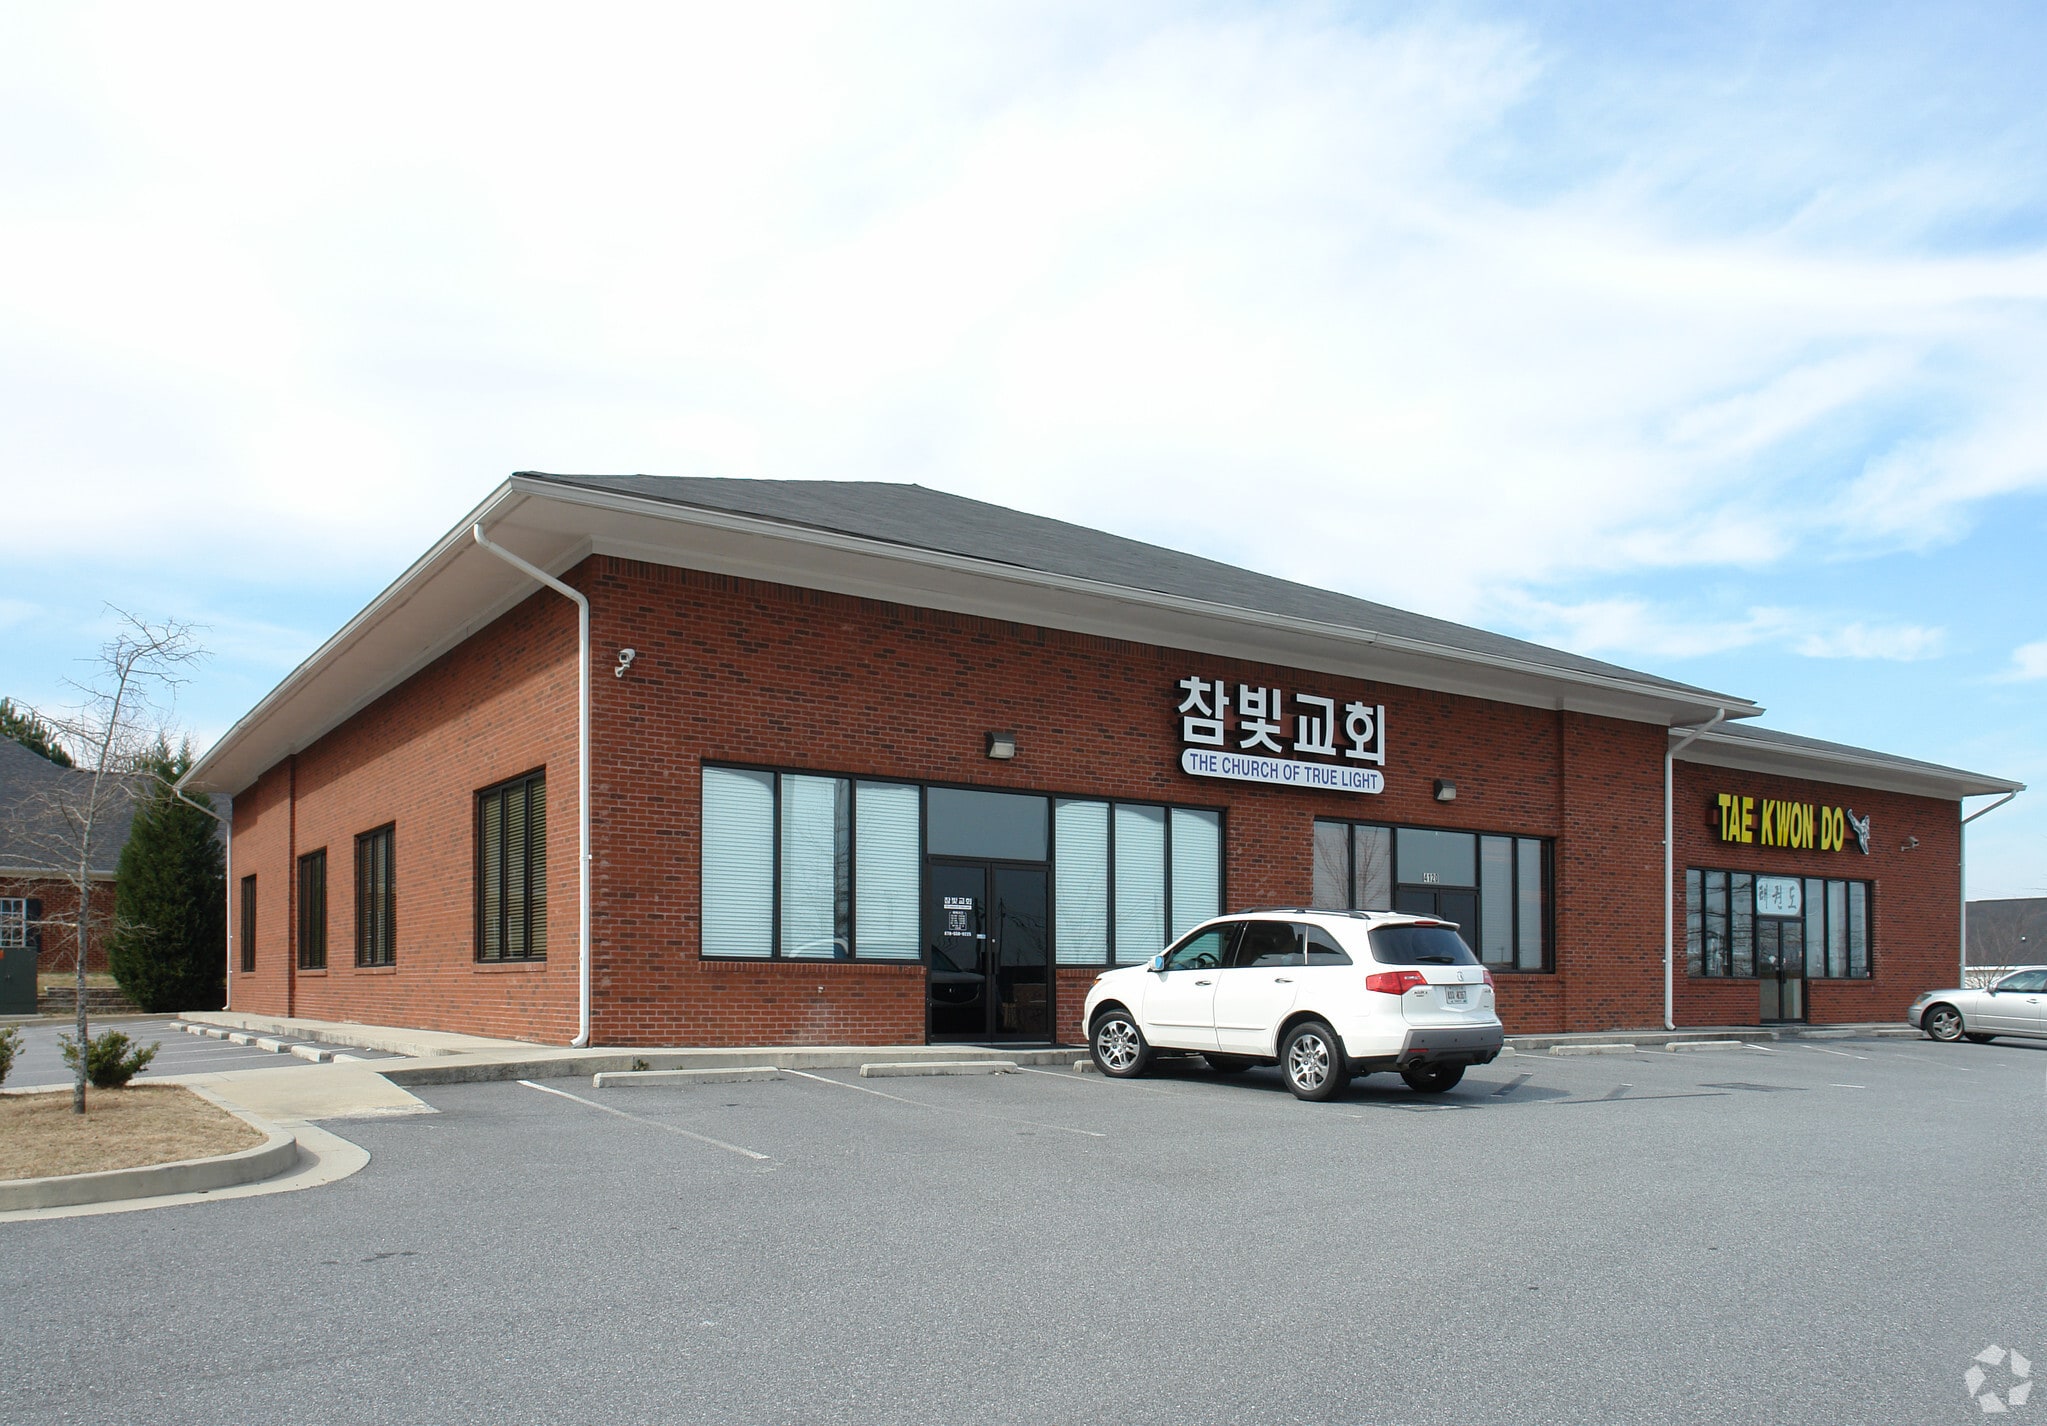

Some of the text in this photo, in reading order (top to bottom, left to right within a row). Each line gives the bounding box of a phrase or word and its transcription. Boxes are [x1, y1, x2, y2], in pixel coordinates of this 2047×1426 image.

[1178, 675, 1386, 767] 참빛교회
[1190, 753, 1378, 790] THE CHURCH OF TRUE LIGHT
[1718, 793, 1845, 852] TAE KWON DO
